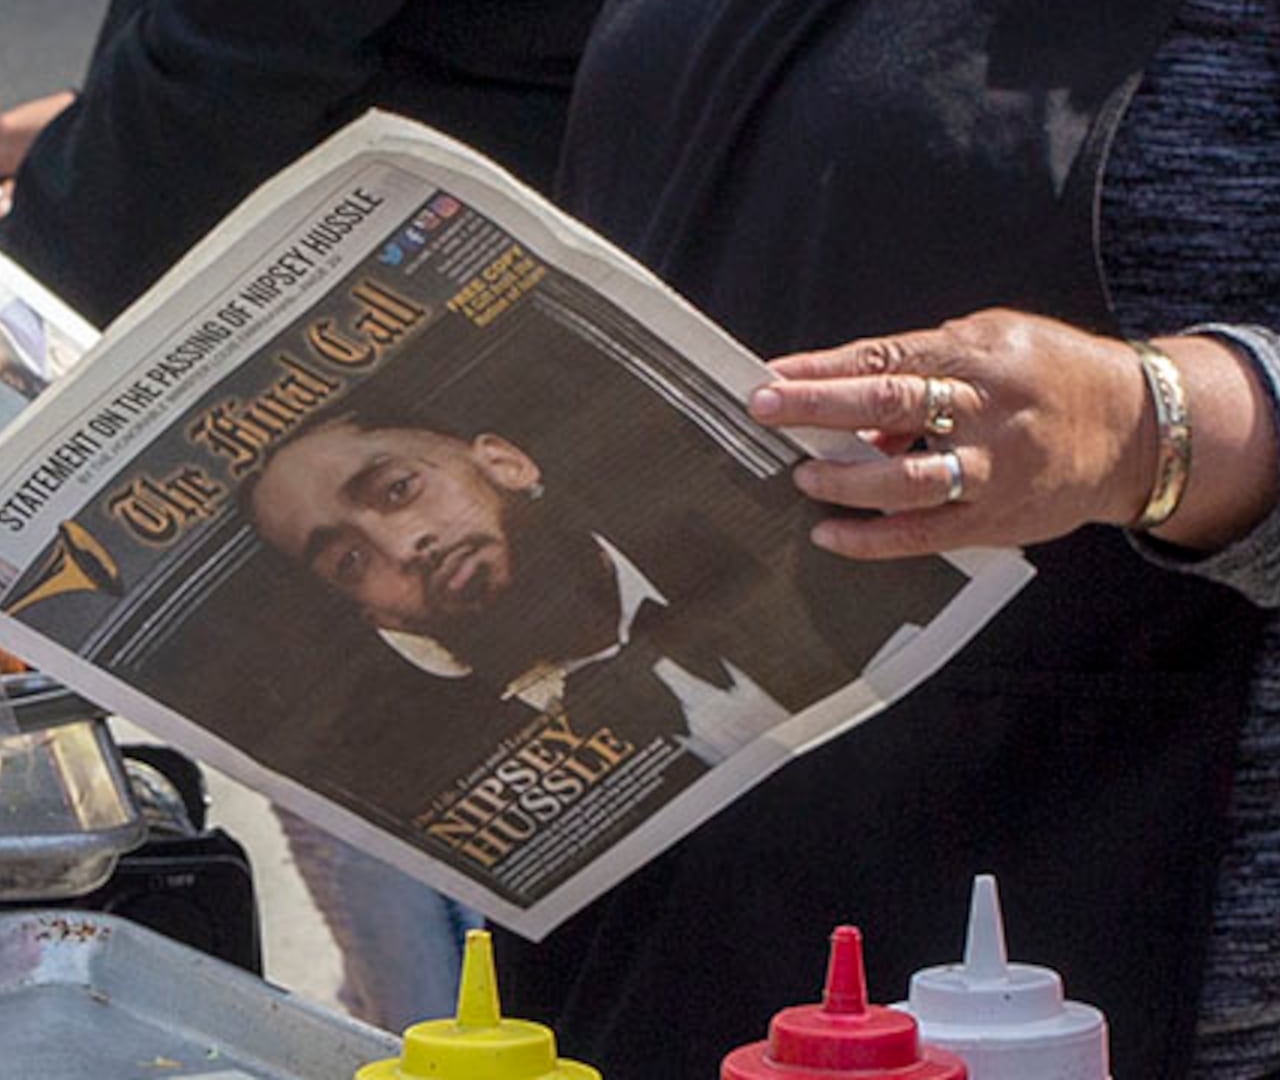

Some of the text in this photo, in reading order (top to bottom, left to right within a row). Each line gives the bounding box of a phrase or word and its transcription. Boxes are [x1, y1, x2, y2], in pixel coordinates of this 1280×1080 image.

[88, 406, 129, 440] ON
[111, 380, 163, 415] THE
[145, 319, 233, 388] PASSING
[217, 299, 254, 331] OF
[238, 245, 314, 310] NIPSEY
[302, 187, 384, 256] HUSSLE
[108, 468, 223, 542] The
[190, 353, 341, 475] Final
[308, 278, 426, 369] Call
[426, 714, 588, 849] NIPSEY
[461, 727, 636, 866] HUSSLE
